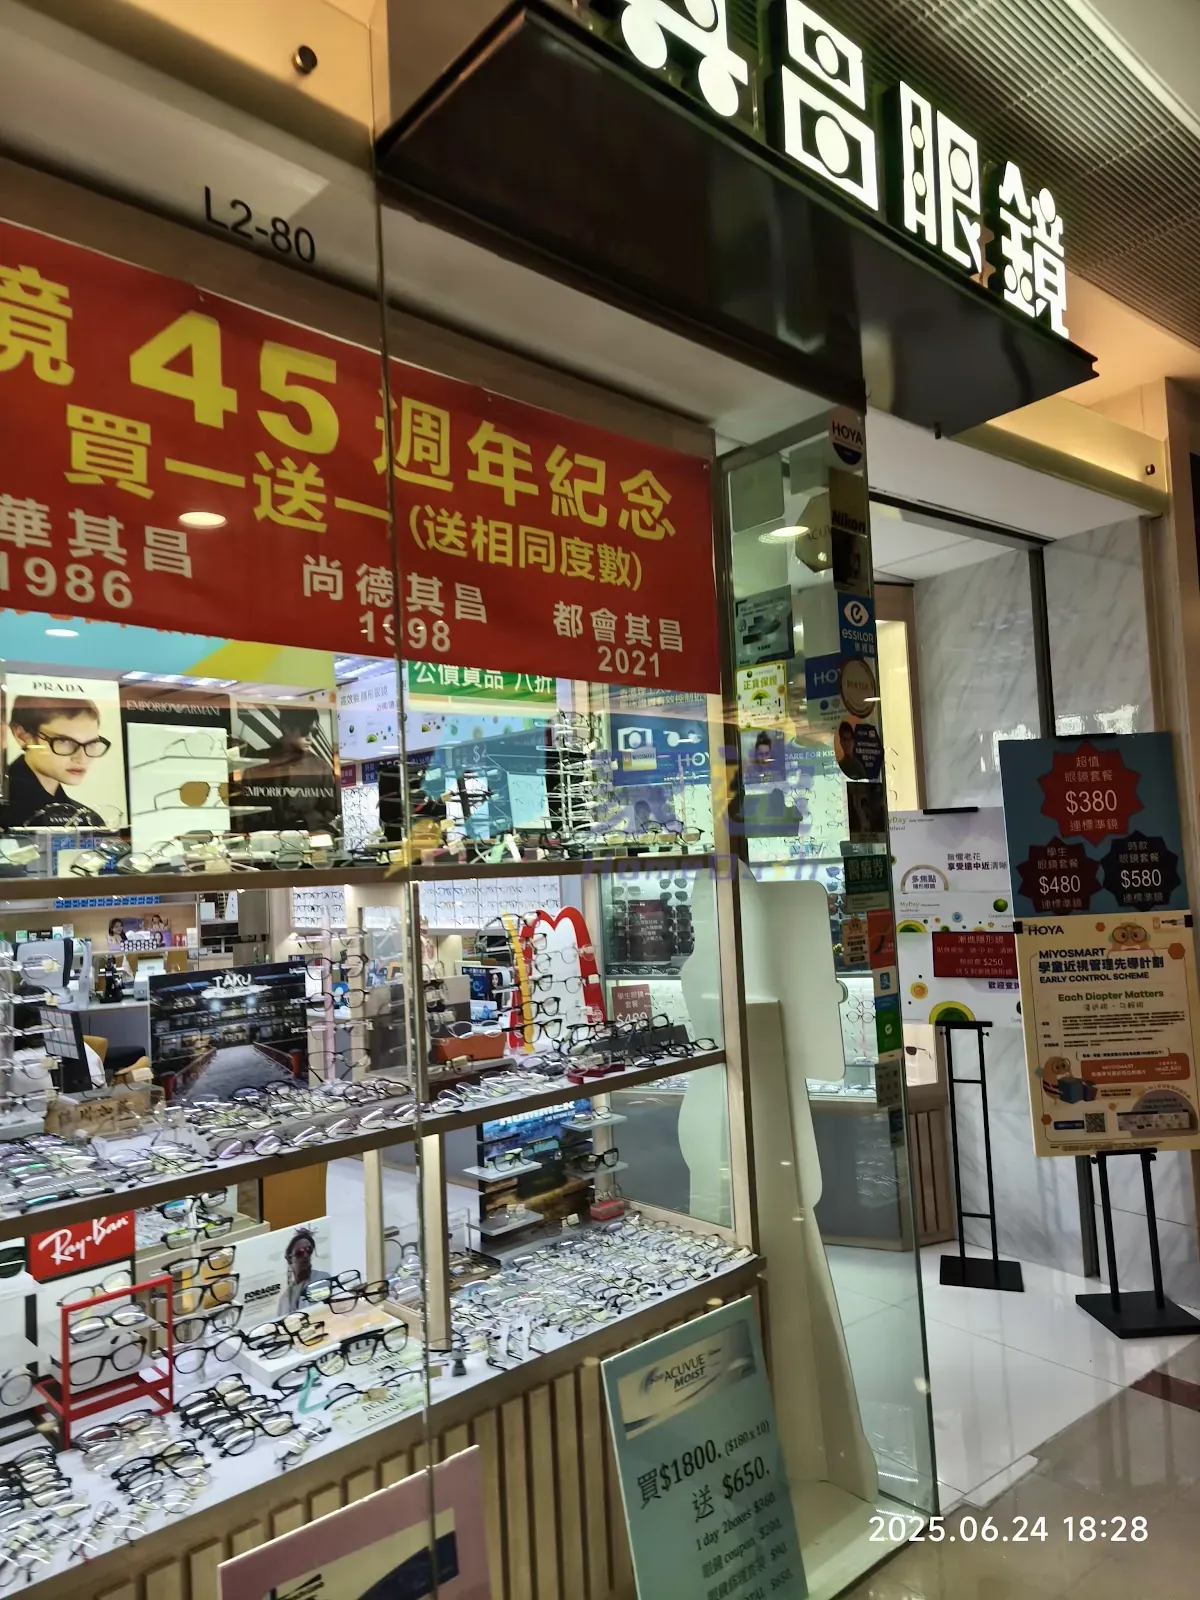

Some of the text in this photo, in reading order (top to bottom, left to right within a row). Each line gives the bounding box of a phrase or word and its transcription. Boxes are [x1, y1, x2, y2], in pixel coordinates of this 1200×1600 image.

[204, 186, 317, 264] L2-80
[832, 420, 863, 446] HOYA
[64, 403, 643, 592] 買一送一 (送相同度數)
[832, 510, 866, 534] Nikon
[302, 554, 488, 625] 尚德其昌
[552, 600, 684, 654] 都會其昌
[0, 553, 133, 609] 1986
[598, 646, 661, 678] 2021
[33, 680, 85, 693] PRADA
[813, 667, 841, 687] HO
[183, 704, 220, 717] ARMANI
[677, 752, 710, 767] HO
[1075, 756, 1100, 767] 超值
[299, 786, 335, 798] ARMANI
[1065, 789, 1117, 815] $380
[1039, 875, 1081, 895] $480
[1120, 868, 1162, 889] $580
[1028, 925, 1065, 936] HOYA
[212, 973, 252, 989] TAKU
[1040, 971, 1149, 984] EARLY CONTROL SCHEME
[1058, 989, 1164, 1002] Each Diopter Matters
[38, 1216, 128, 1266] Ray-Ban
[244, 1283, 281, 1300] FORAGER
[664, 1353, 706, 1383] ACUVUE
[673, 1365, 707, 1390] MOIST
[692, 1456, 770, 1523] 送 $650.
[703, 1529, 719, 1547] day
[725, 1534, 757, 1564] coupon
